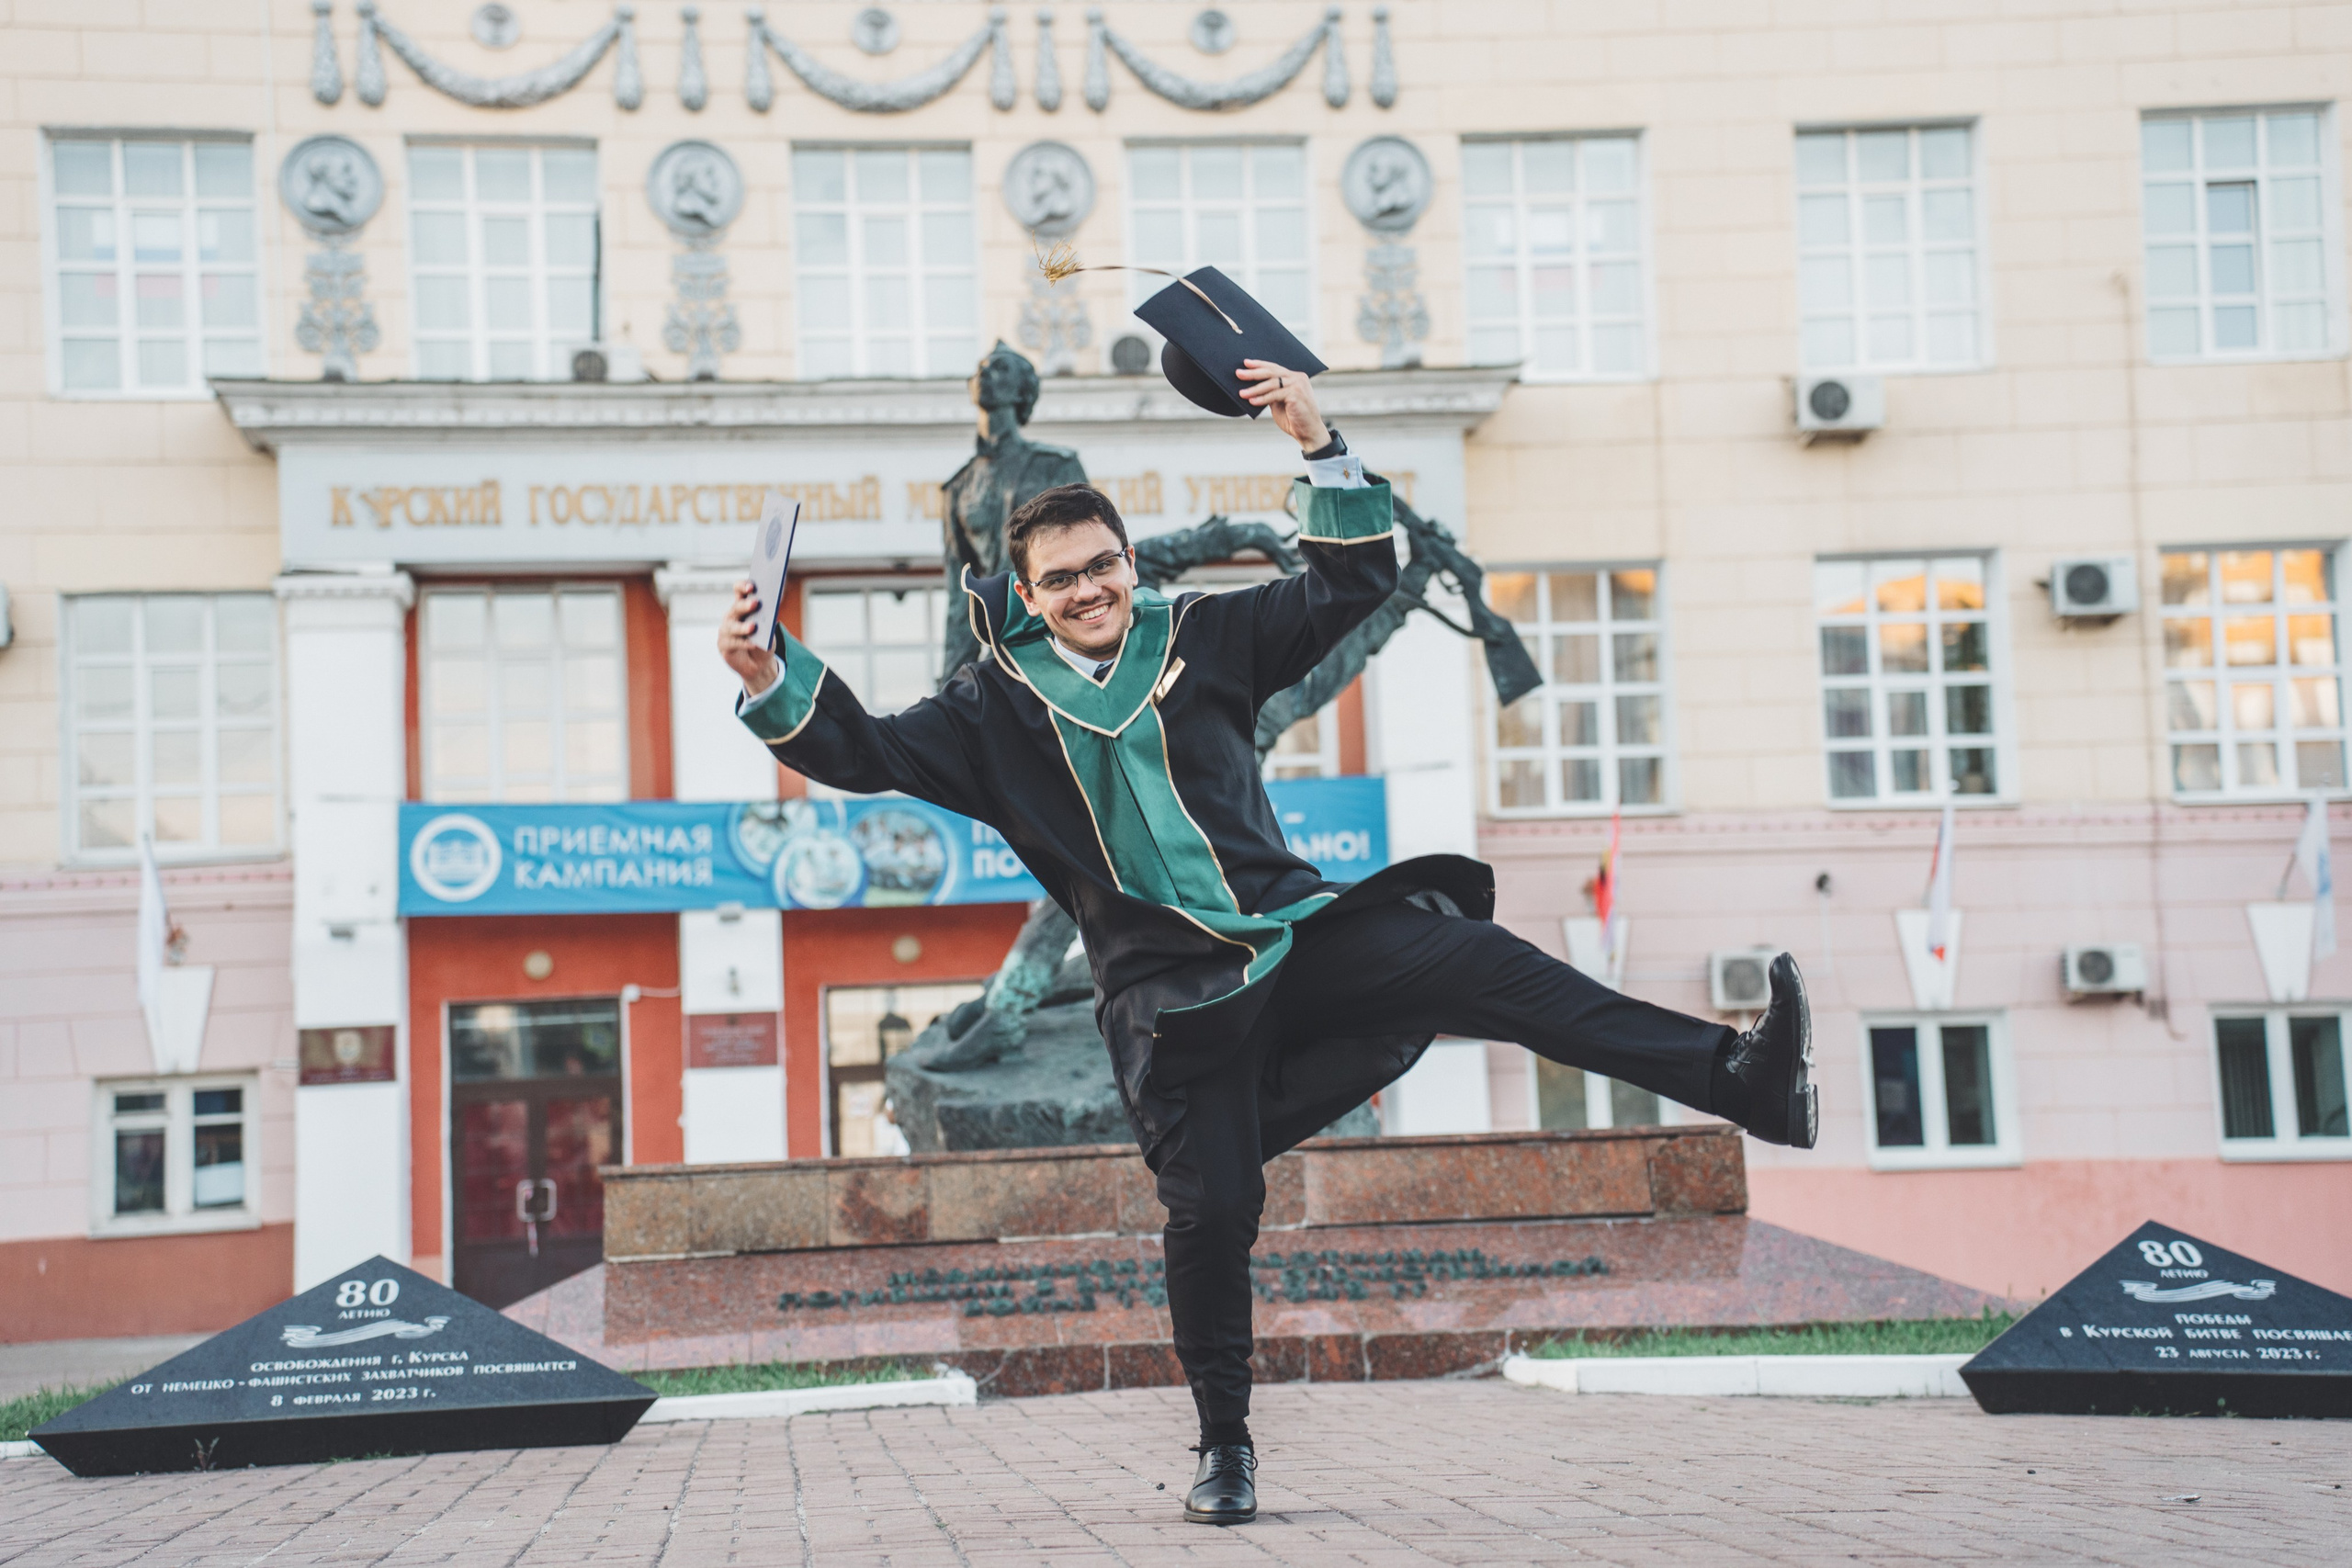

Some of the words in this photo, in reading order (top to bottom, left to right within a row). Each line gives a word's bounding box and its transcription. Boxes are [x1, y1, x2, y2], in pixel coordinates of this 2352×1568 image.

[331, 480, 502, 526] КУРСКИЙ
[514, 824, 713, 855] ПРИЕМНАЯ
[514, 858, 713, 889] КАМПАНИЯ
[2137, 1240, 2203, 1268] 80
[2160, 1269, 2210, 1279] ЛЕТИЮ
[335, 1278, 401, 1308] 80
[337, 1308, 391, 1320] ЛЕТИЮ
[2174, 1313, 2253, 1325] ПОБЕДЫ
[2082, 1324, 2174, 1339] КУРСКОЙ
[2184, 1327, 2242, 1339] БИТВЕ
[2154, 1346, 2180, 1359] 23
[2188, 1348, 2251, 1359] АВГУСТА
[2256, 1347, 2303, 1359] 2023
[250, 1356, 381, 1372] ОСВОБОЖДЕНИЯ
[130, 1383, 153, 1394] ОТ
[359, 1362, 465, 1382] ЗАХВАТЧИКОВ
[270, 1394, 284, 1407] 8
[292, 1392, 362, 1405] ФЕВРАЛЯ
[370, 1386, 418, 1402] 2023
